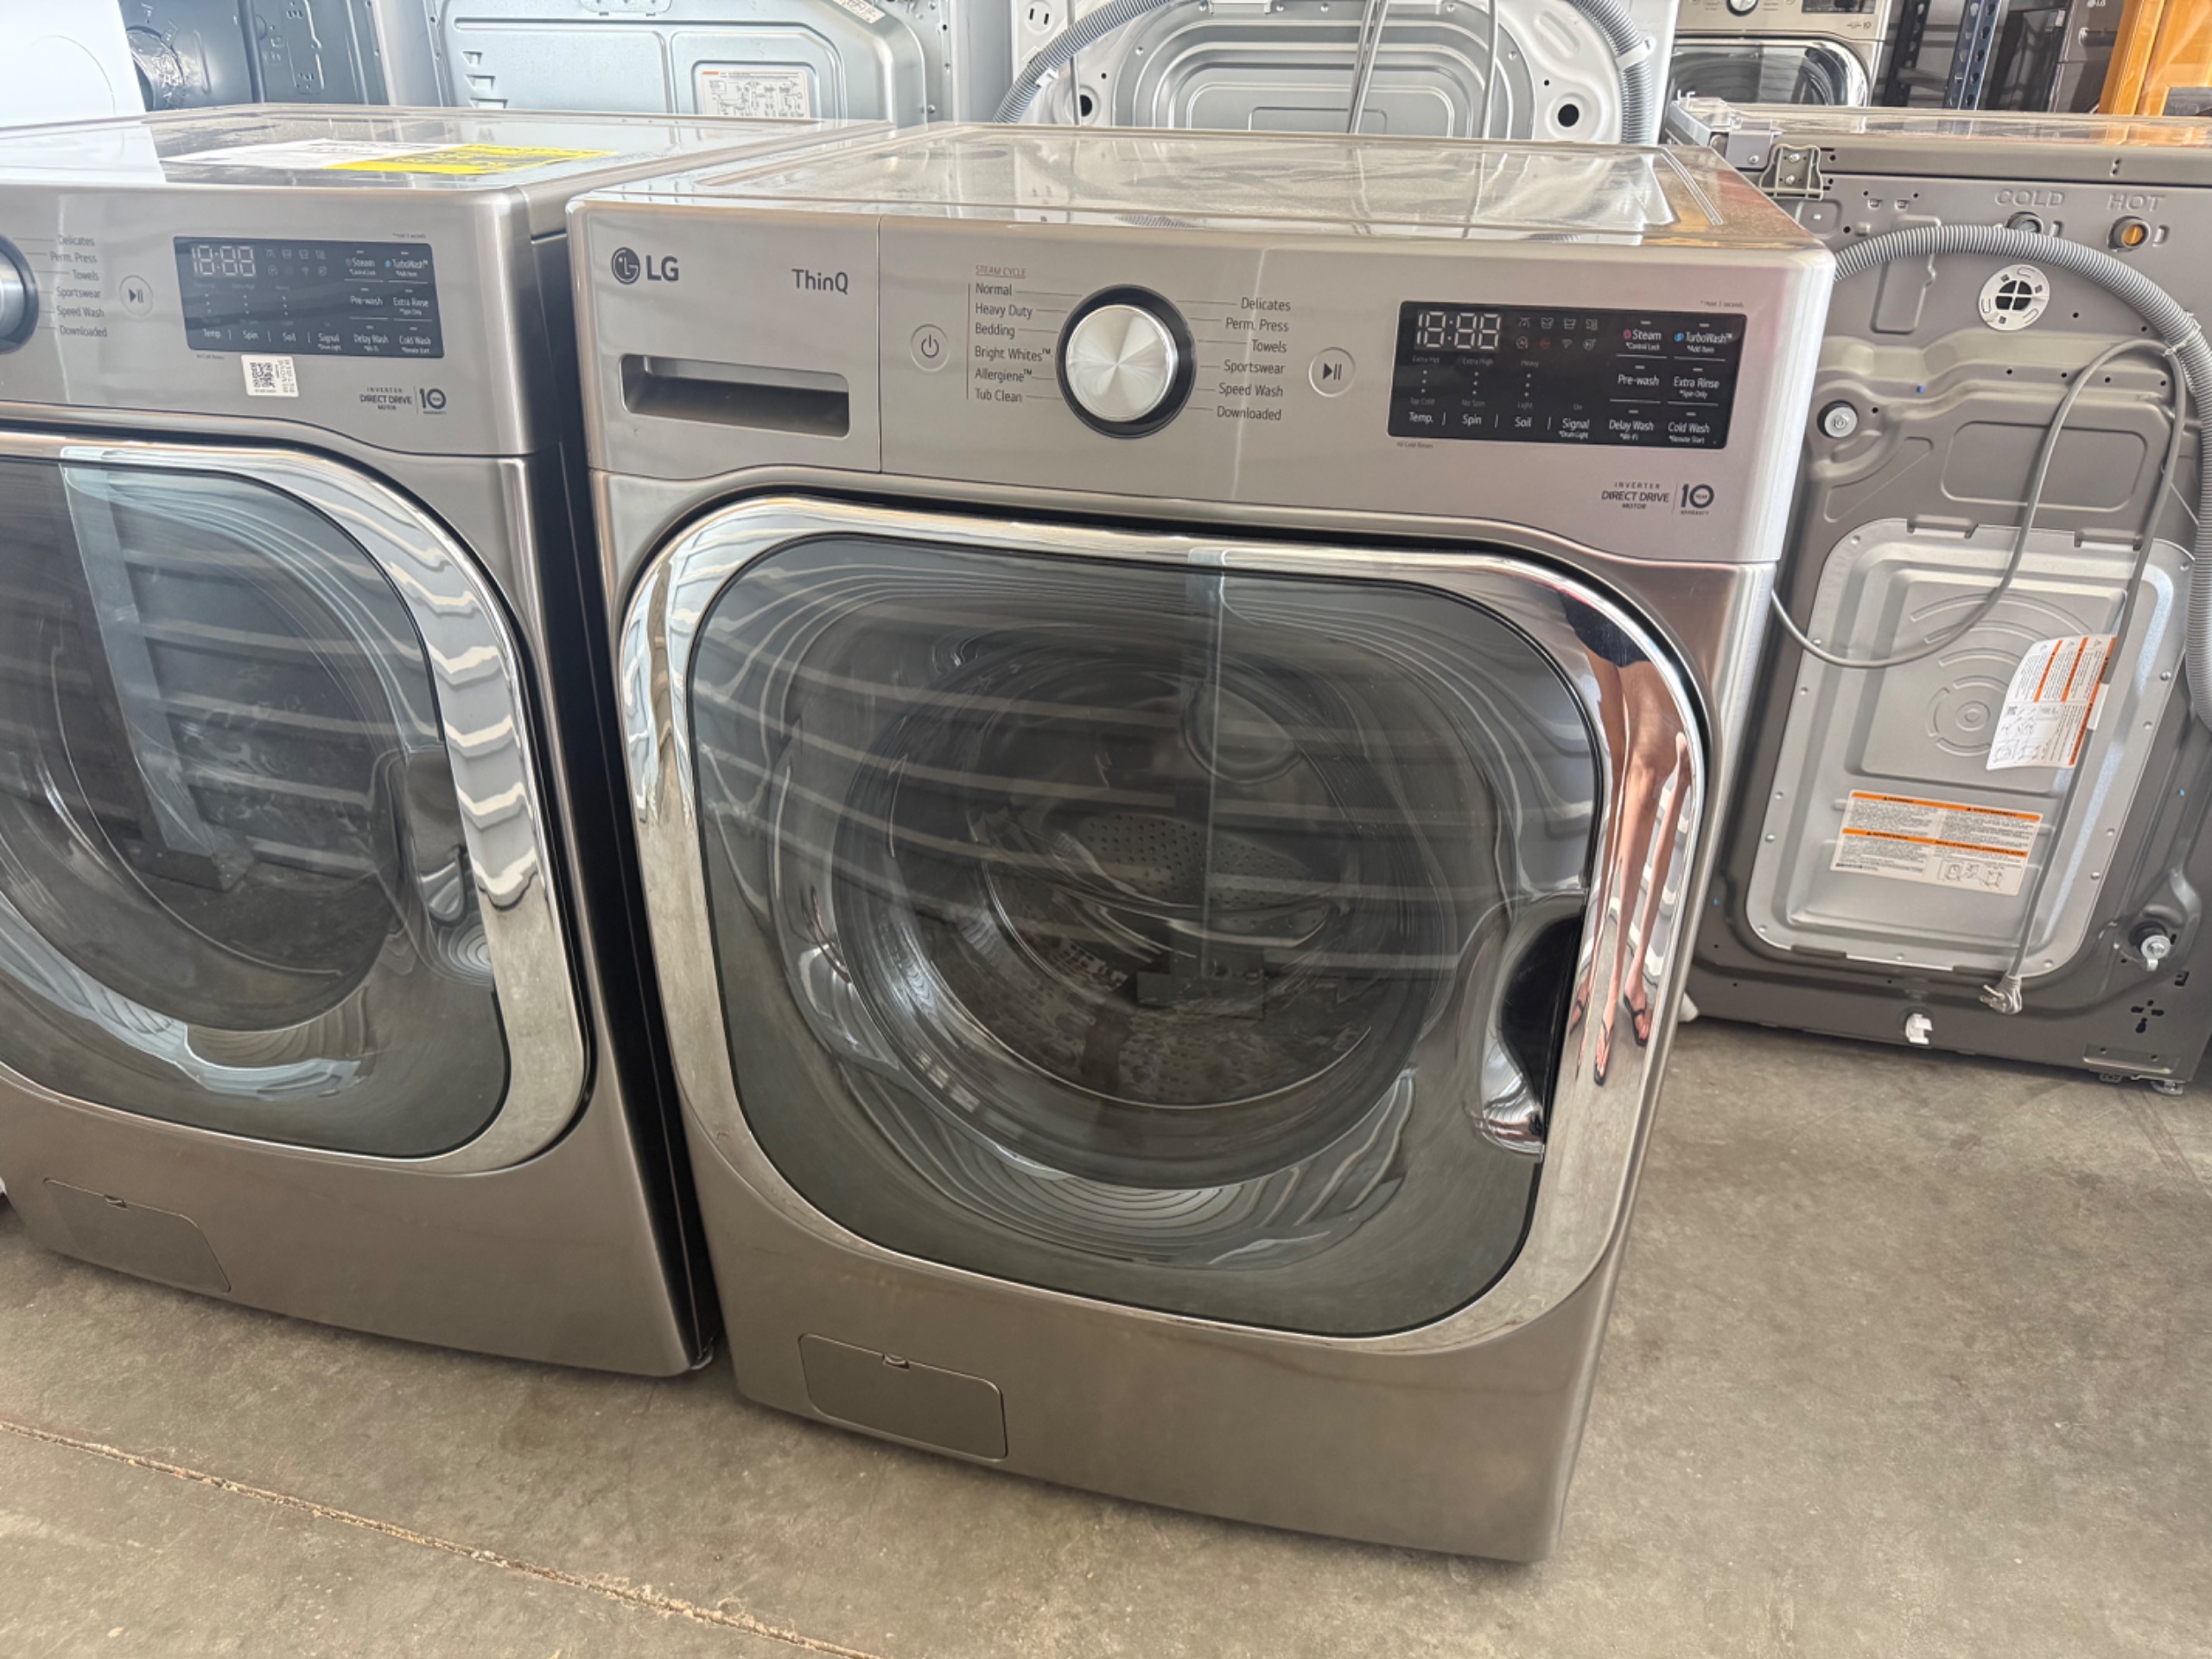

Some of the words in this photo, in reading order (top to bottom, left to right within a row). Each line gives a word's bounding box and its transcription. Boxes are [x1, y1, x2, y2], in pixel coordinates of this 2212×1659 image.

[1994, 188, 2065, 207] COLD
[2107, 193, 2165, 212] HOT
[57, 234, 95, 246] Delicates
[74, 252, 97, 264] Press
[73, 269, 99, 281] Towels
[645, 255, 679, 282] LG
[976, 265, 1002, 278] STEAM
[1003, 267, 1026, 279] CYCLE
[791, 268, 849, 296] ThinQ
[56, 287, 101, 299] Sportswear
[976, 283, 1012, 296] Normal
[1241, 297, 1291, 311] Delicates
[57, 305, 81, 318] Speed
[83, 307, 105, 318] Wash
[976, 302, 1006, 318] Heavy
[1008, 304, 1033, 321] Duty
[60, 325, 108, 337] Downloaded
[976, 322, 1015, 340] Bedding
[1225, 317, 1255, 330] Perm.
[1259, 319, 1289, 333] Press
[1632, 329, 1662, 340] Steam
[1252, 339, 1287, 353] Towels
[975, 346, 1004, 361] Bright
[1224, 359, 1285, 374] Sportswear
[1618, 373, 1660, 386] Pre-wash
[1674, 376, 1694, 388] Extra
[1697, 378, 1719, 390] Rinse
[975, 389, 992, 400] Tub
[995, 390, 1022, 403] Clean
[1218, 382, 1252, 397] Speed
[1255, 385, 1283, 397] Wash
[359, 394, 387, 404] DIRECT
[389, 395, 412, 404] DRIVE
[419, 388, 446, 410] 10
[1217, 405, 1281, 421] Downloaded
[1408, 411, 1433, 424] Temp.
[1462, 414, 1482, 427] Spin
[1514, 416, 1532, 428] Soil
[1562, 418, 1590, 430] Signal
[1609, 419, 1631, 432] Delay
[1632, 421, 1655, 431] Wash
[1668, 422, 1688, 433] Cold
[1688, 423, 1710, 433] Wash
[1601, 490, 1637, 501] DIRECT
[1639, 492, 1670, 503] DRIVE
[1681, 483, 1714, 509] 10
